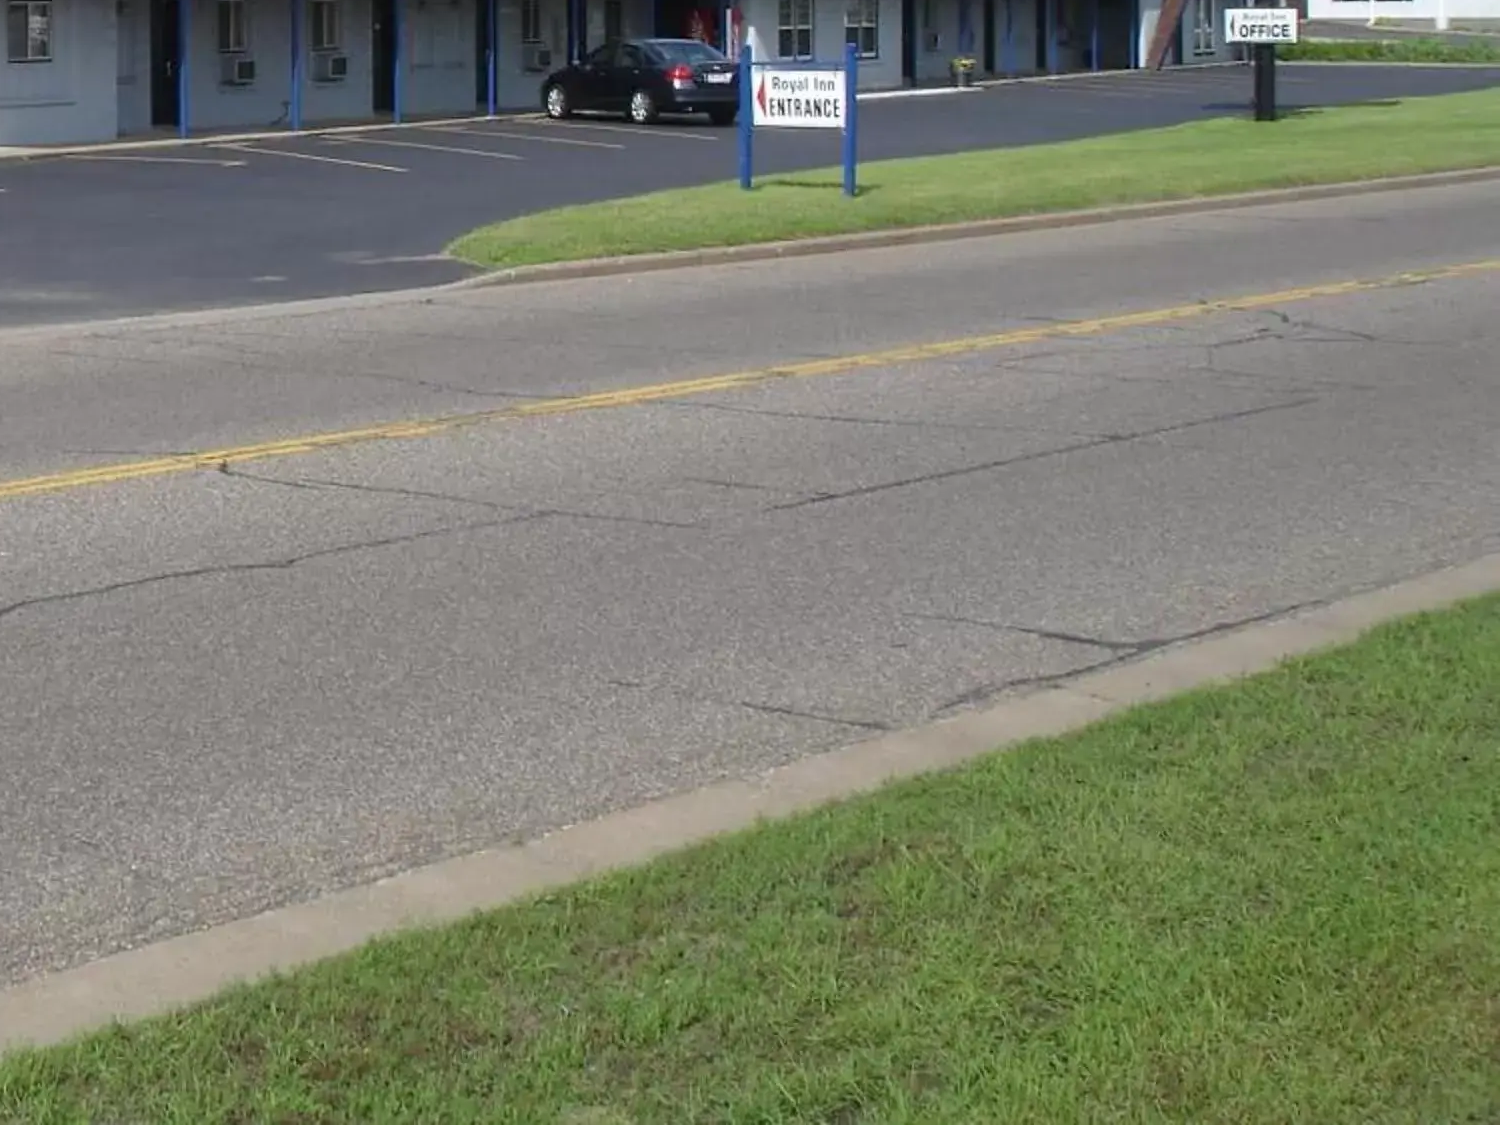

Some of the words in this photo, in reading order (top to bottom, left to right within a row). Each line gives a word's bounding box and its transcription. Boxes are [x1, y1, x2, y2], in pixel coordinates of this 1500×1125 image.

[1239, 24, 1291, 38] OFFICE
[771, 76, 809, 94] Royal
[813, 76, 835, 92] Inn
[769, 97, 841, 118] ENTRANCE
